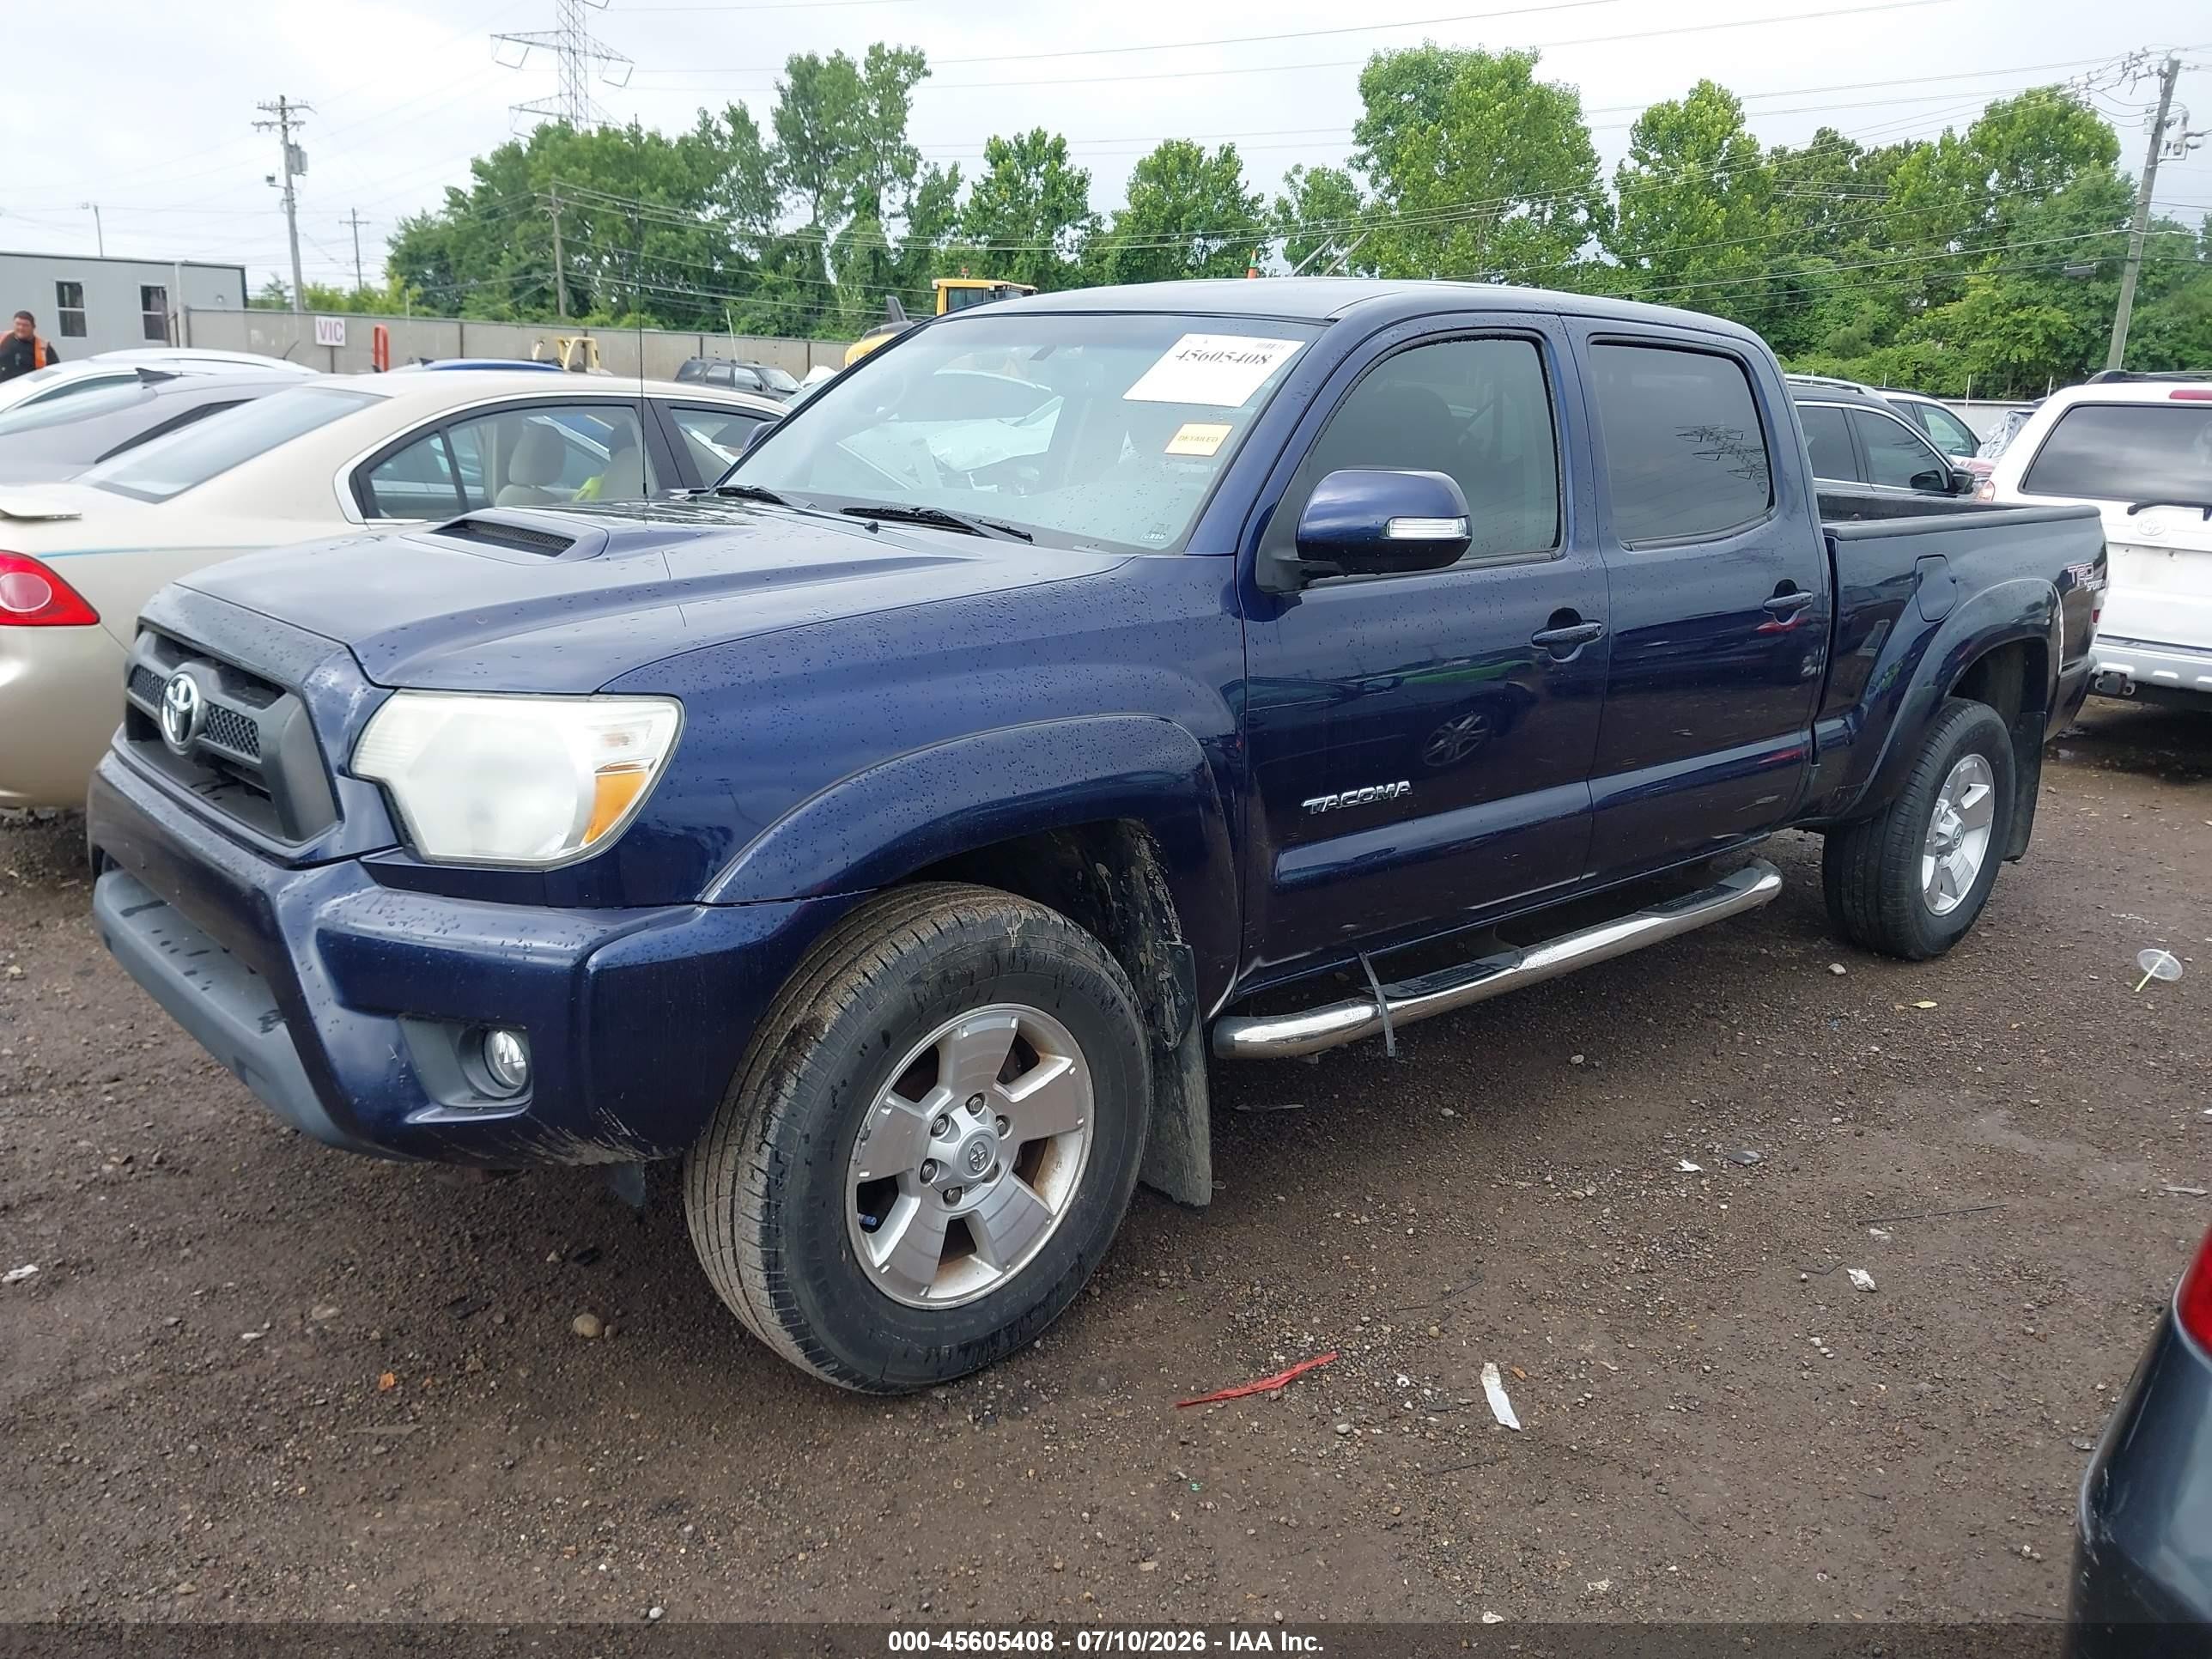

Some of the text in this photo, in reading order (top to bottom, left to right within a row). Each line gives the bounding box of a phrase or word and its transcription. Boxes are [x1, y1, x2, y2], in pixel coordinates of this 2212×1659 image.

[318, 321, 343, 343] VIC
[1175, 349, 1273, 364] 45605408
[2067, 562, 2094, 587] TRD
[1300, 781, 1413, 815] TACOMA
